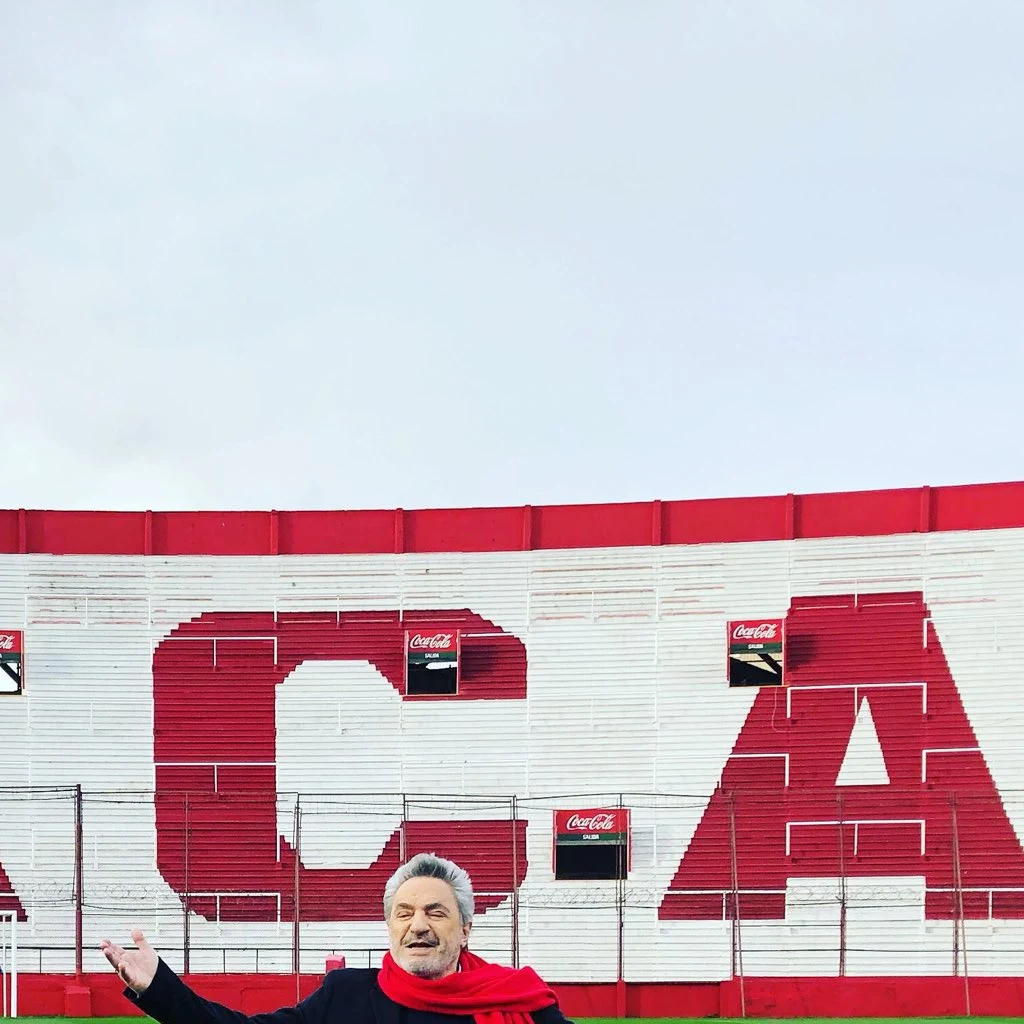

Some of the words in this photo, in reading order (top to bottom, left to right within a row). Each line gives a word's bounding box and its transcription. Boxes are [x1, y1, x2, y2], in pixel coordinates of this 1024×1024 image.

[732, 623, 780, 639] Coca-Cola
[409, 633, 454, 649] Coca-Cola
[566, 813, 617, 831] Coca-Cola
